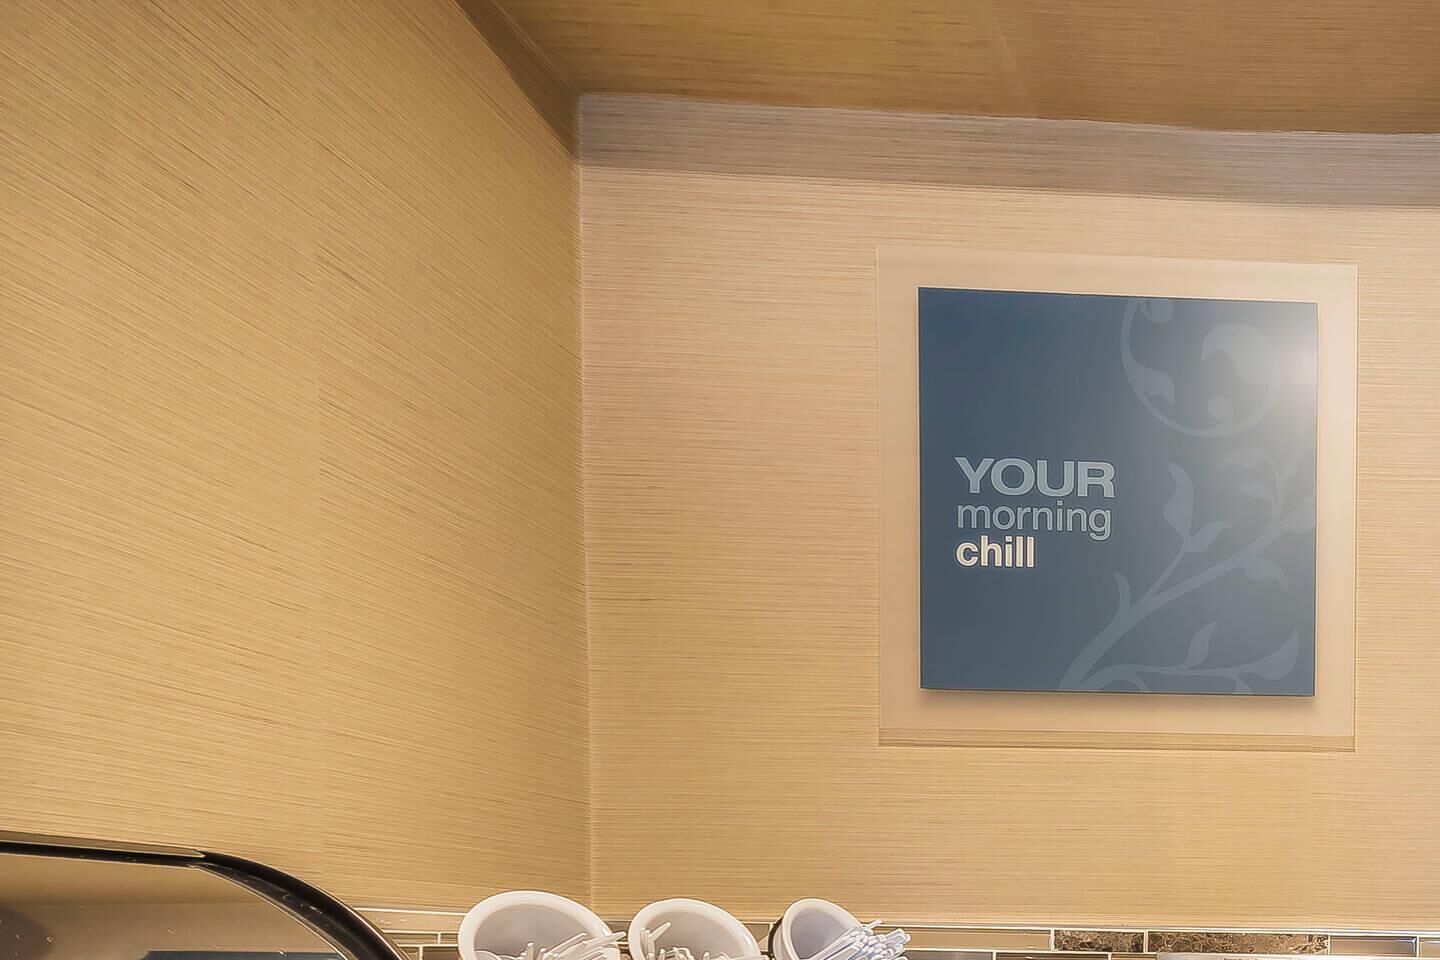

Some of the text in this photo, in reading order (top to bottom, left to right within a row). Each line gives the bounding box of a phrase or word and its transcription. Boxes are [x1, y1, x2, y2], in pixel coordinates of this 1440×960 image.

[954, 457, 1115, 497] YOUR
[957, 500, 1111, 541] morning
[956, 535, 1035, 568] chill
